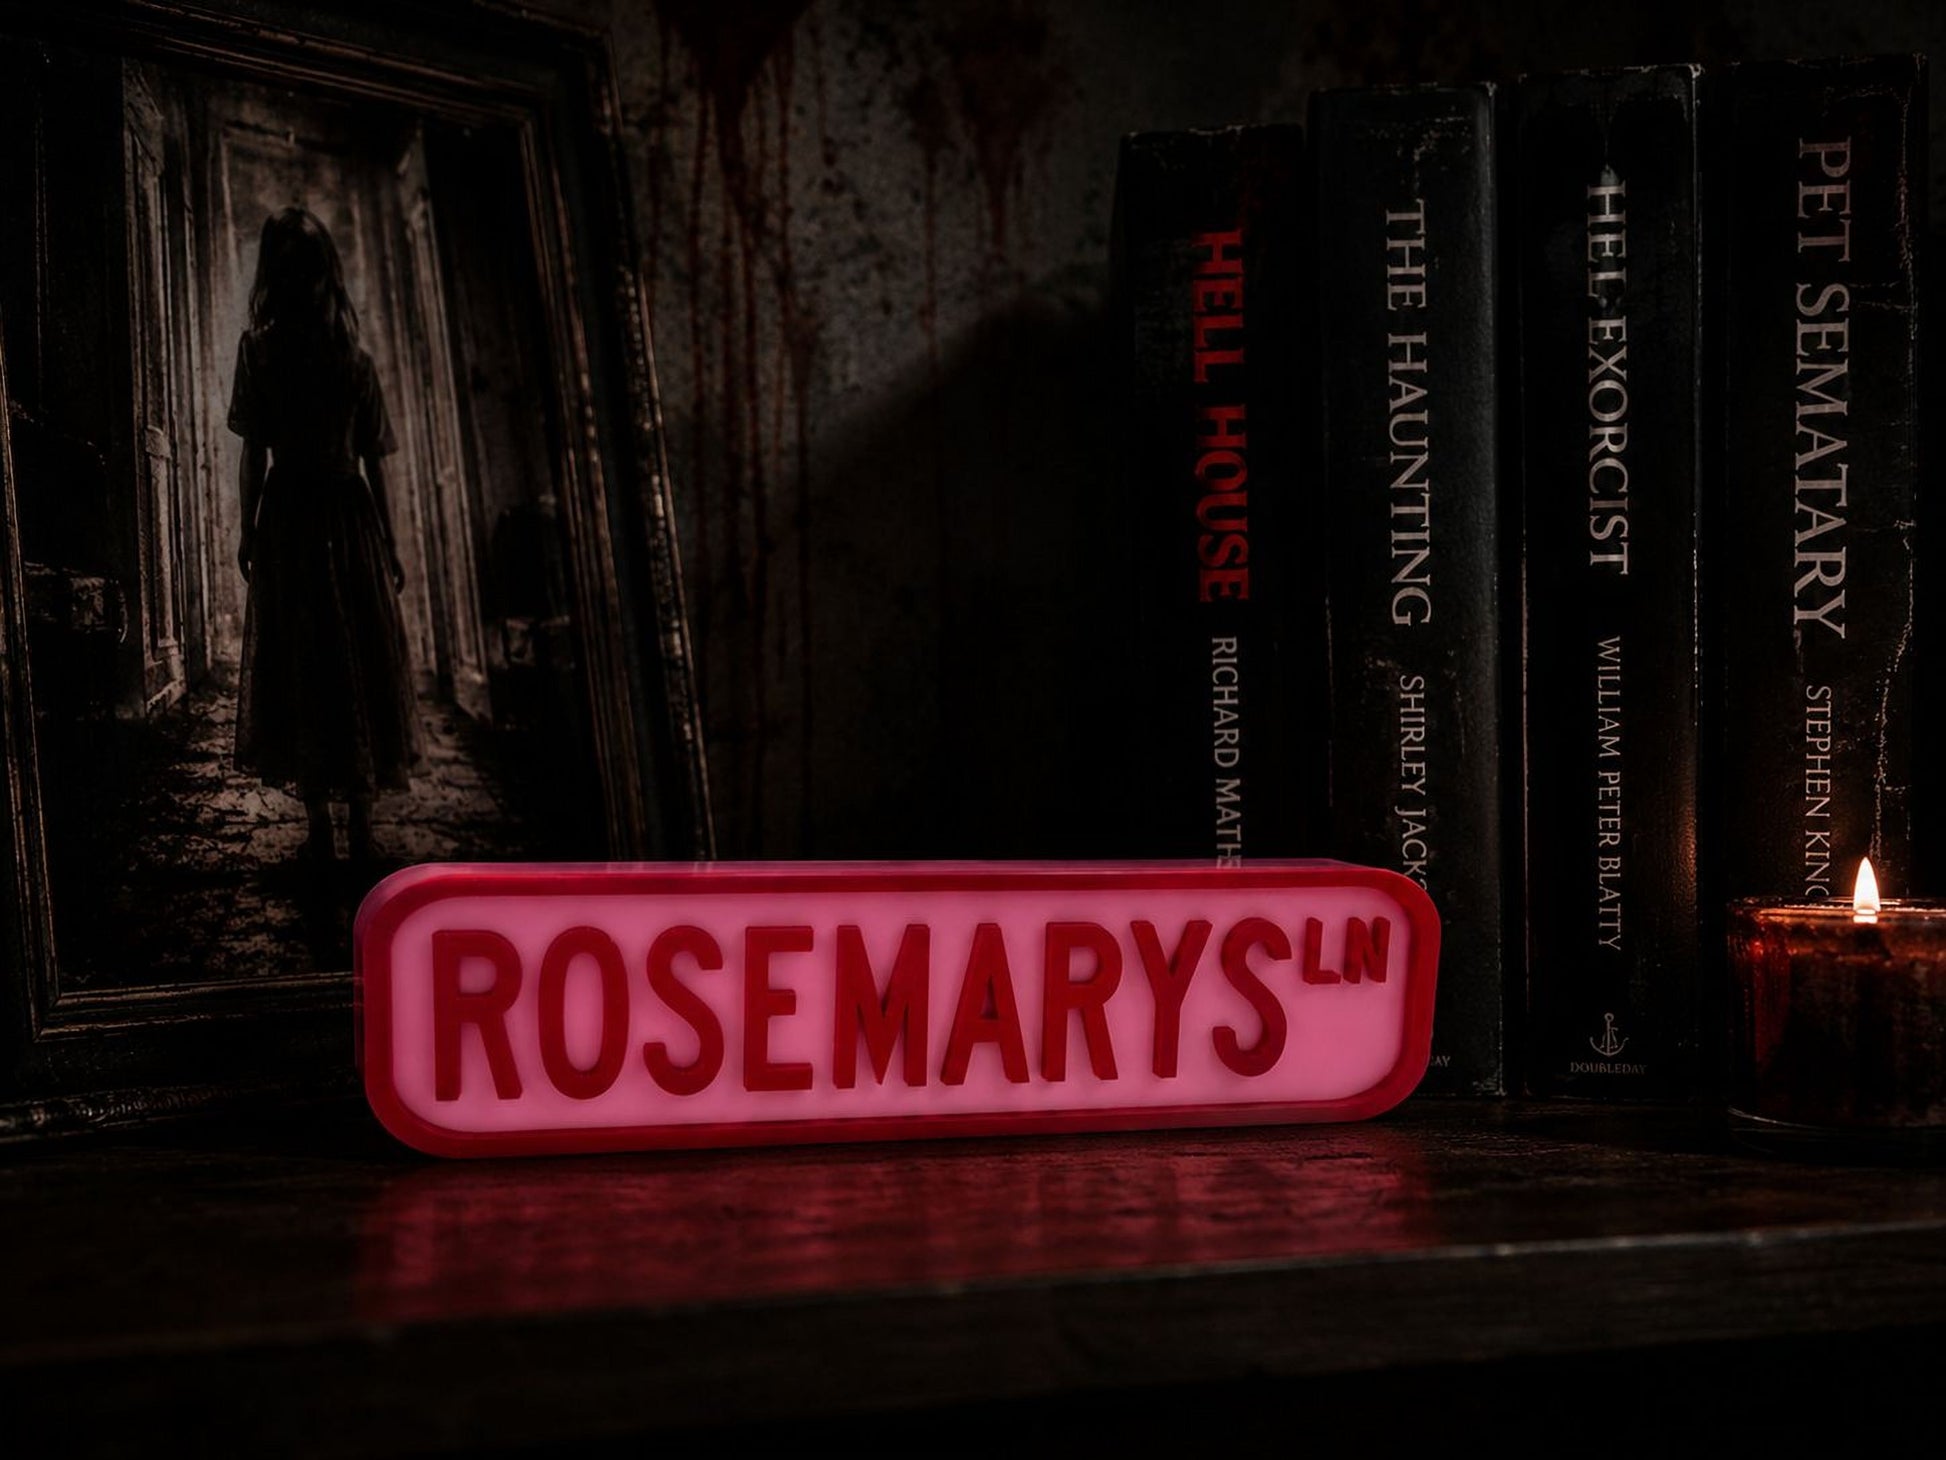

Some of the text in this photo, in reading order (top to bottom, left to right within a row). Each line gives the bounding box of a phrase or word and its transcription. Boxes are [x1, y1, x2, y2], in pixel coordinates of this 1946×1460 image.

[1191, 228, 1251, 603] HELL HOUSE
[1385, 200, 1432, 627] THE HAUNTING
[1587, 315, 1632, 576] EXORCIST
[1790, 136, 1852, 640] PET SEMATARY
[1211, 636, 1240, 769] RICHARD
[1400, 675, 1427, 797] SHIRLEY
[1596, 636, 1622, 951] WILLIAM PETER BLATTY
[1804, 685, 1832, 818] STEPHEN
[432, 916, 1391, 1101] ROSEMARYS LN
[1569, 1061, 1647, 1074] DOUBLEDAY
